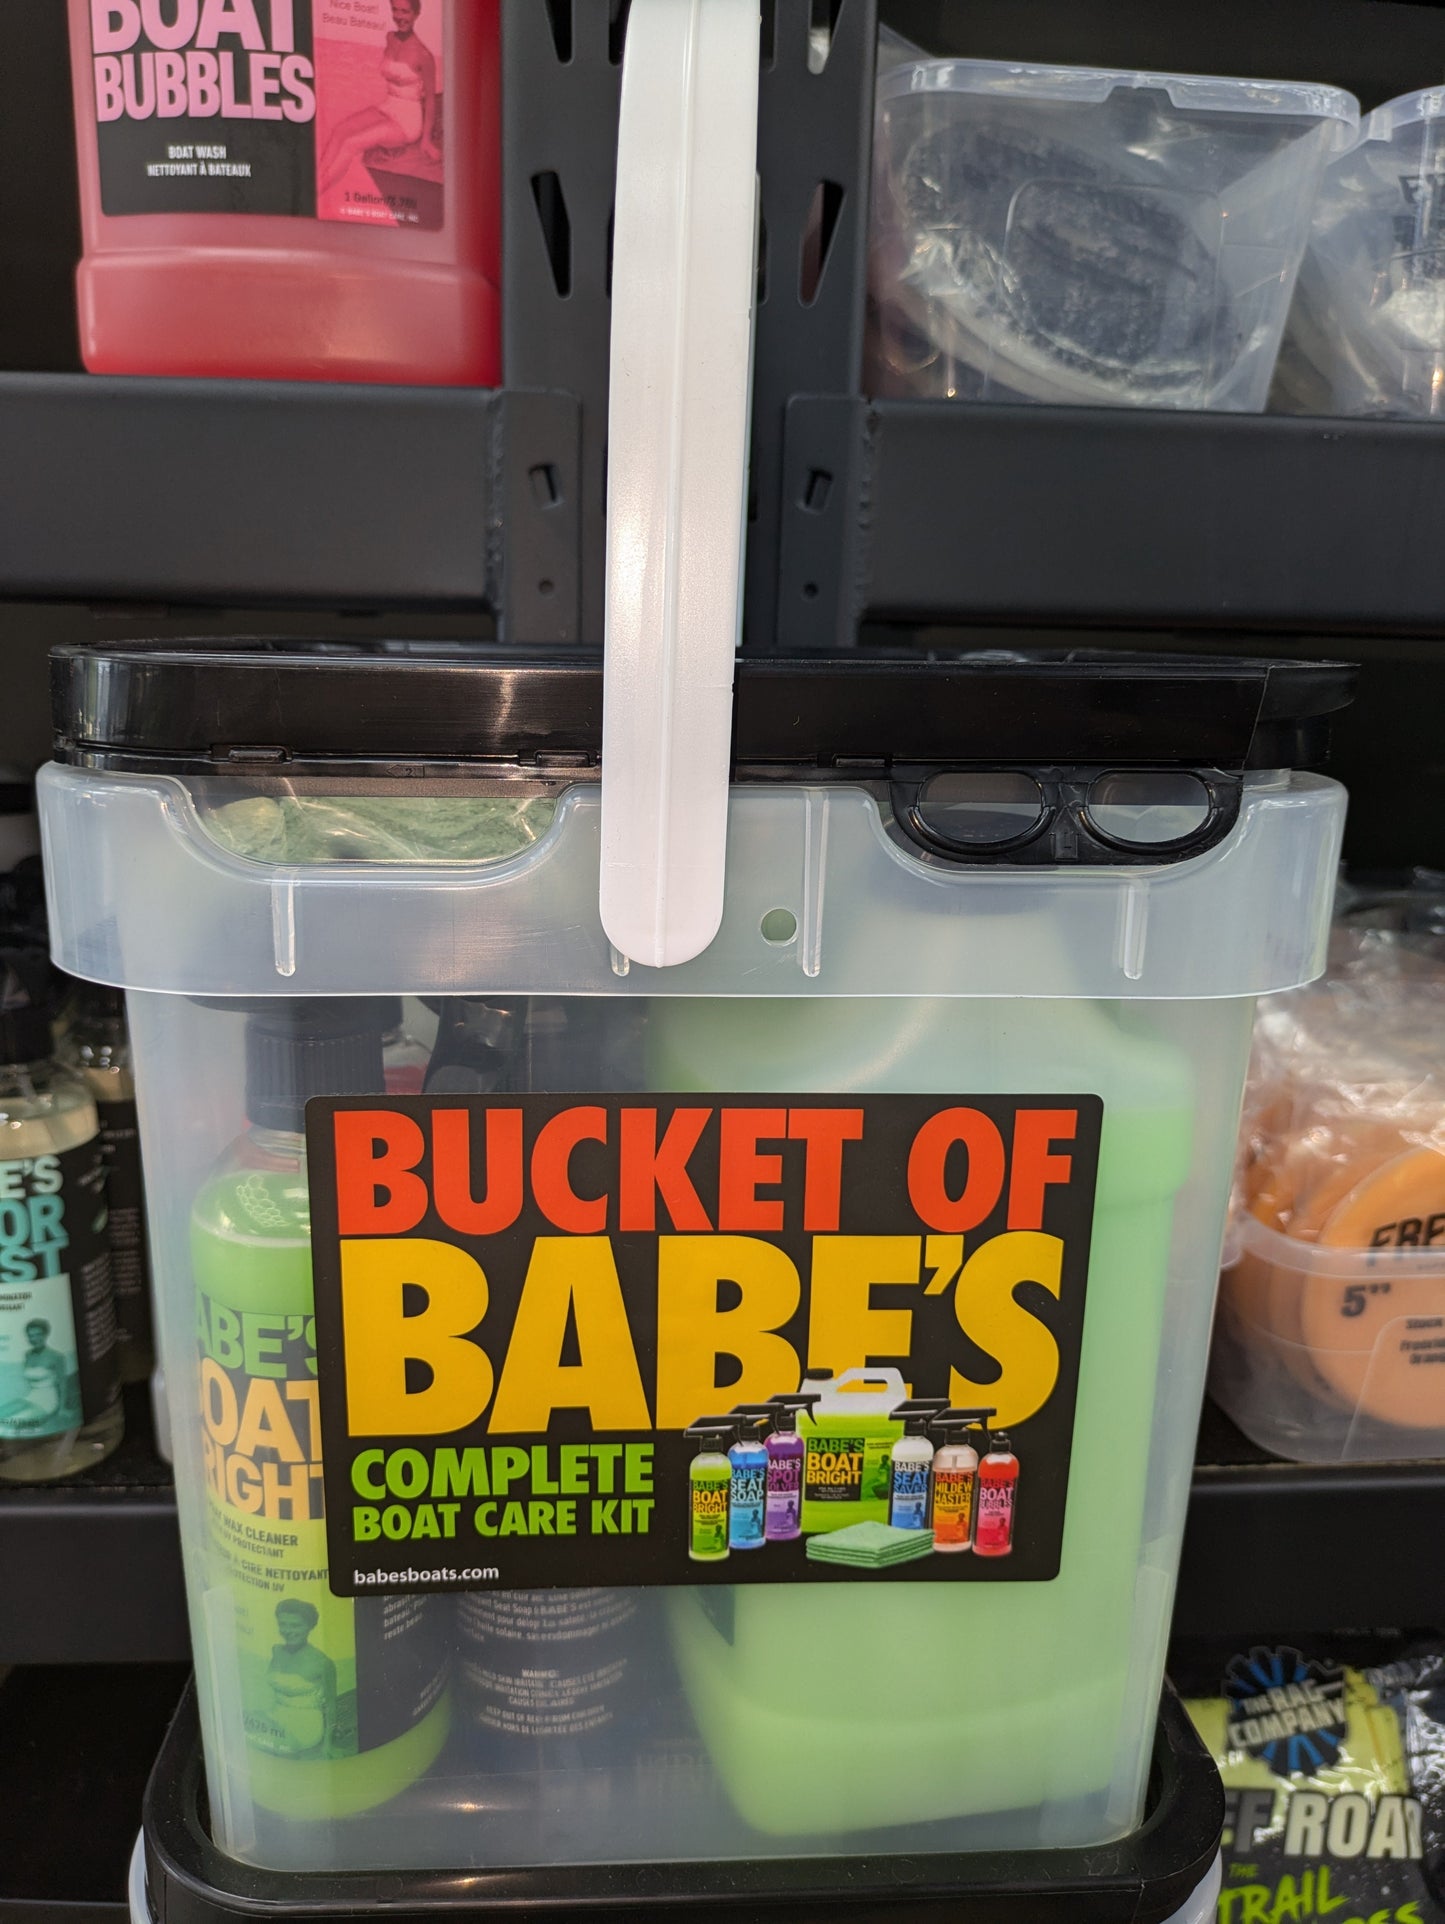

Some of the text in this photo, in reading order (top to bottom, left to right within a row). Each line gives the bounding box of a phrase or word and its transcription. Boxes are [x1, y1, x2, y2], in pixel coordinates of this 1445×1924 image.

[95, 51, 316, 123] BUBBLES
[168, 145, 227, 159] BOAT WASH
[147, 163, 198, 176] NETTOYANT
[207, 163, 252, 177] BATEAUX
[334, 1106, 1078, 1235] BUCKET OF
[340, 1230, 1064, 1437] BABE'S
[197, 1355, 324, 1462] OAT
[807, 1438, 864, 1453] BABE'S
[807, 1452, 863, 1471] BOAT
[894, 1460, 930, 1472] BABE'S
[351, 1443, 655, 1500] COMPLETE
[806, 1470, 862, 1485] BRIGHT
[894, 1471, 929, 1485] SEAT
[692, 1479, 729, 1491] BABE'S
[731, 1478, 765, 1492] SEAT
[692, 1489, 728, 1503] BOAT
[731, 1490, 765, 1502] SOAP
[980, 1487, 1014, 1500] BOAT
[692, 1502, 728, 1513] BRIGHT
[353, 1498, 655, 1542] BOAT CARE KIT
[245, 1525, 299, 1547] CLEANER
[233, 1535, 285, 1559] PROTECTANT
[265, 1567, 329, 1581] NETTOYANT
[353, 1566, 500, 1585] babesboats.com
[1228, 1697, 1345, 1748] COMPANY
[1217, 1864, 1350, 1924] TRAIL
